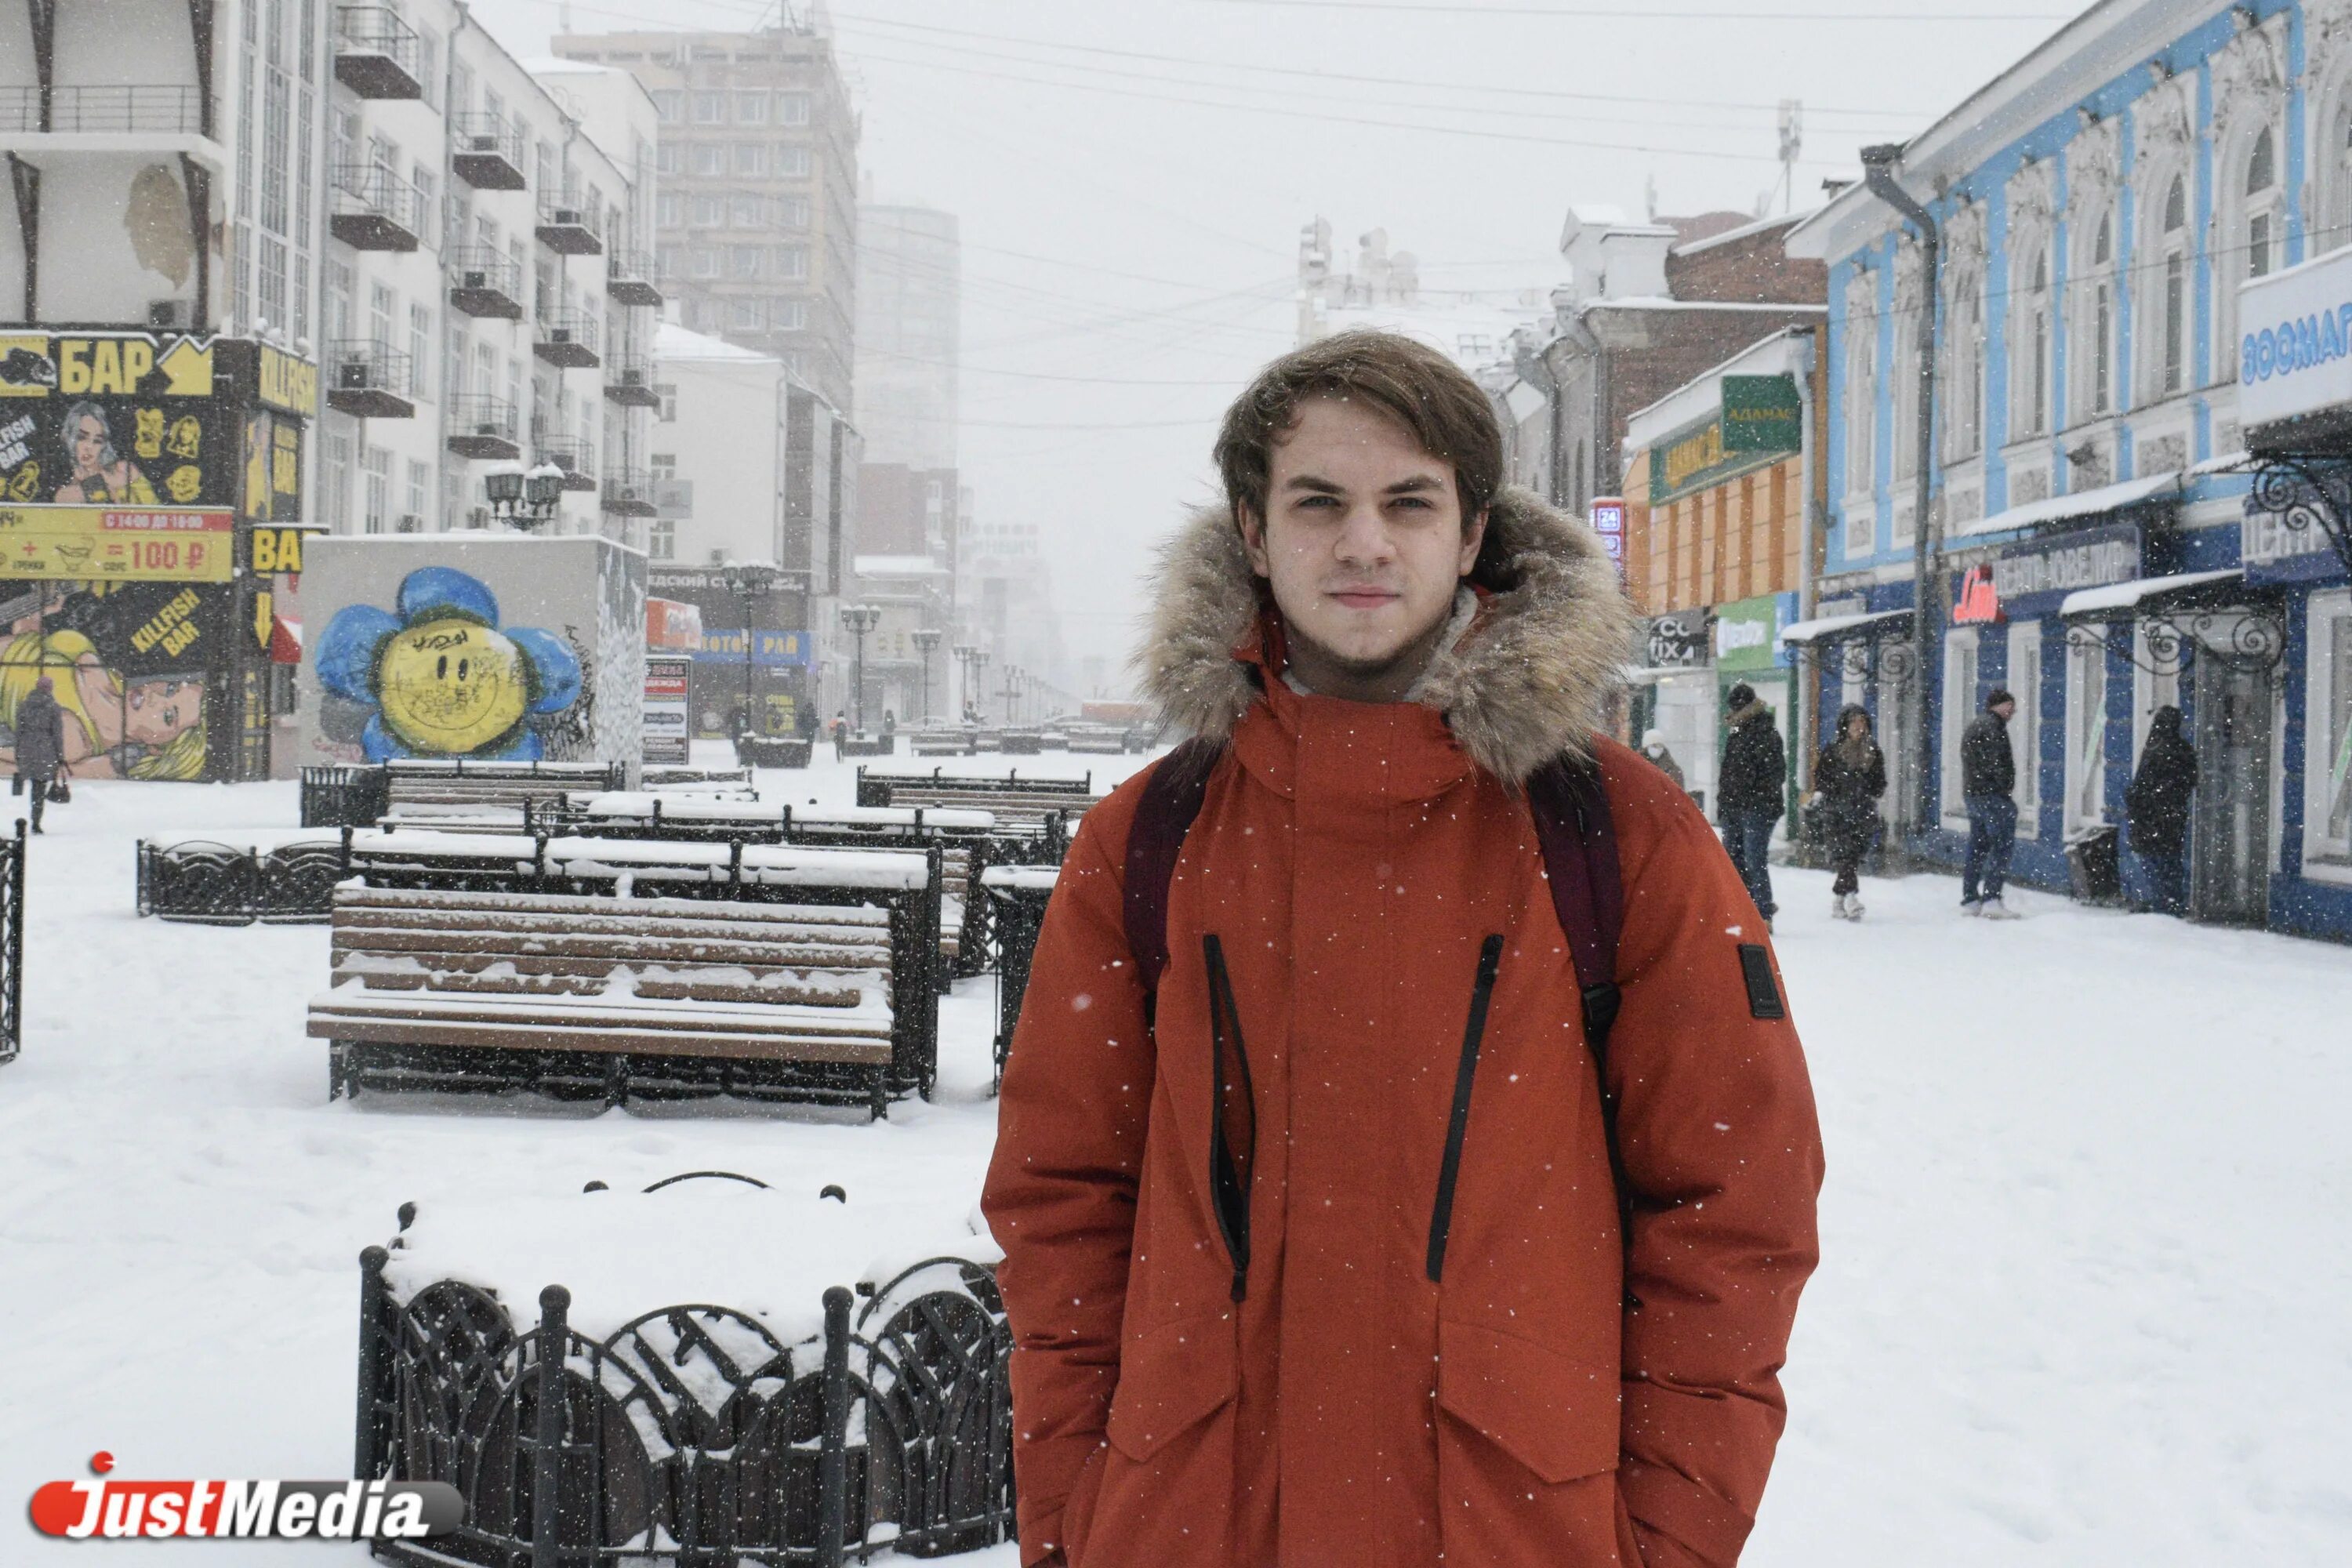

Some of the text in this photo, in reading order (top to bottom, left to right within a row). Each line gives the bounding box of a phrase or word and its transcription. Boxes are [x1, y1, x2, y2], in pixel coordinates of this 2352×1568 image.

[60, 339, 154, 394] БАР
[132, 541, 178, 570] 100
[252, 530, 303, 572] BA
[130, 587, 201, 653] KILLFISH
[161, 620, 201, 658] BAR
